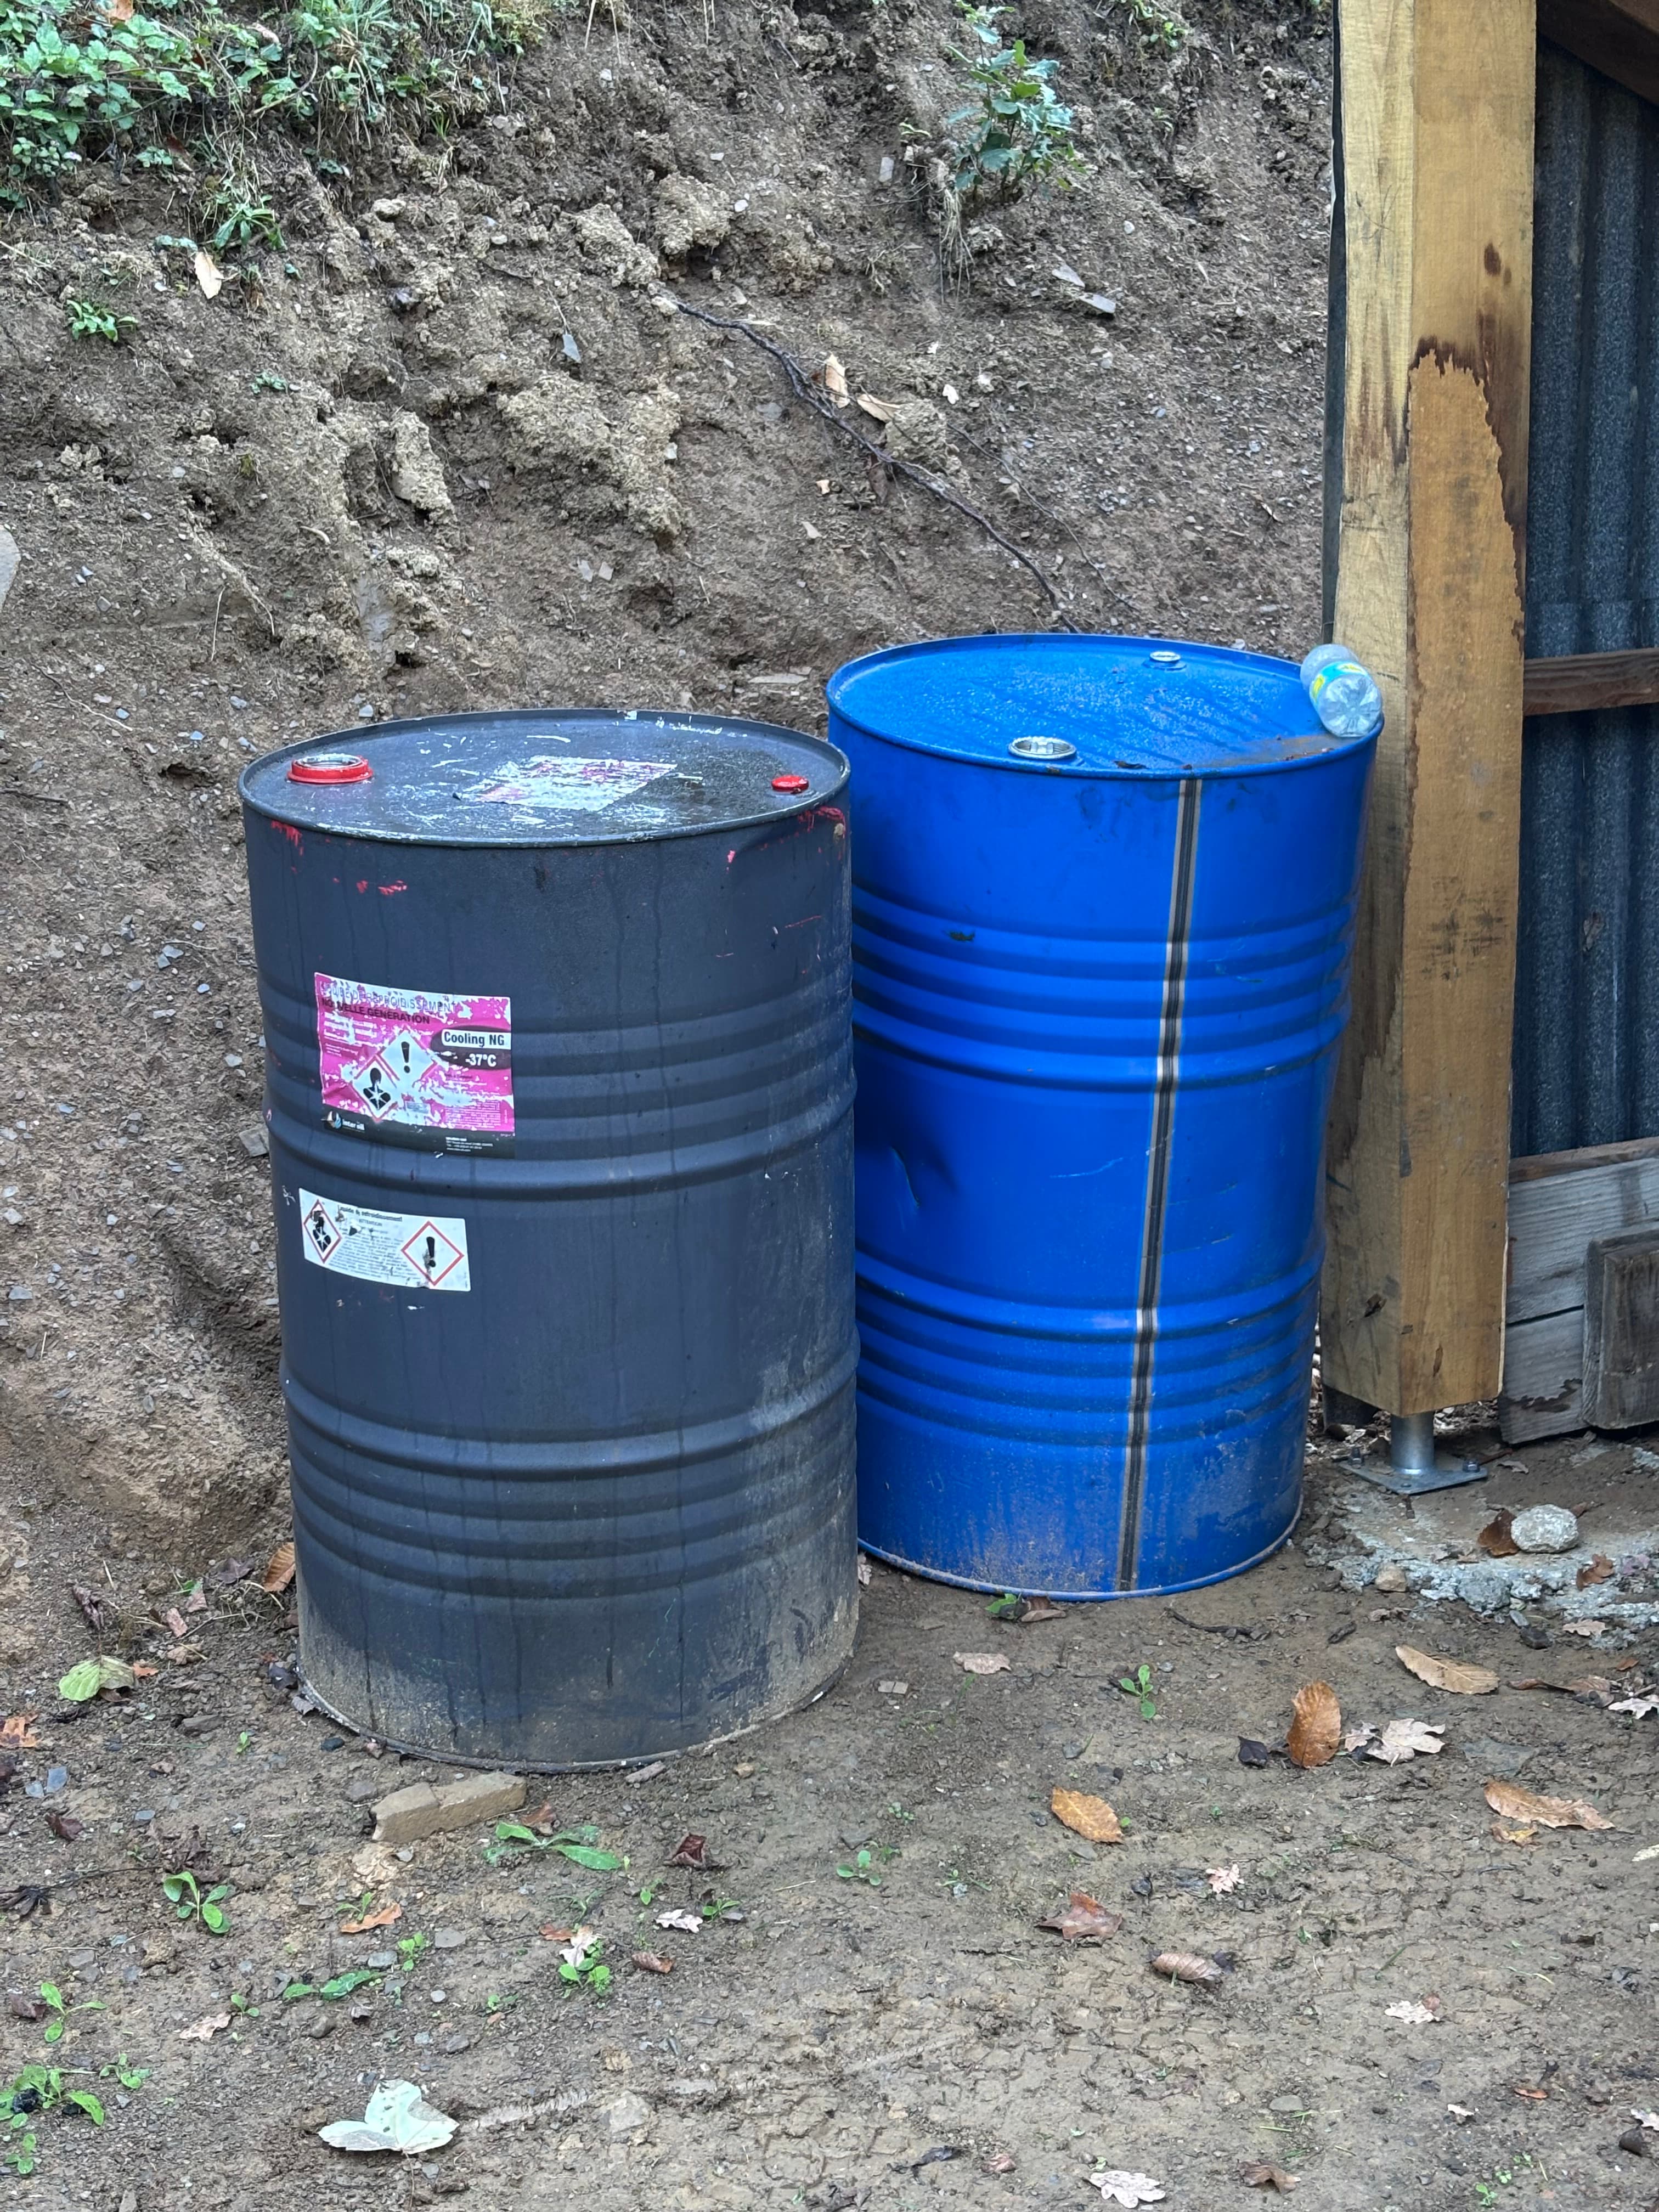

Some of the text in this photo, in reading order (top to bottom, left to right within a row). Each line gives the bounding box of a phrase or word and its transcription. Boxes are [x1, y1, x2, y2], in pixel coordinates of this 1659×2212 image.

[444, 1031, 505, 1047] Cooling NG
[465, 1053, 496, 1067] -37°C
